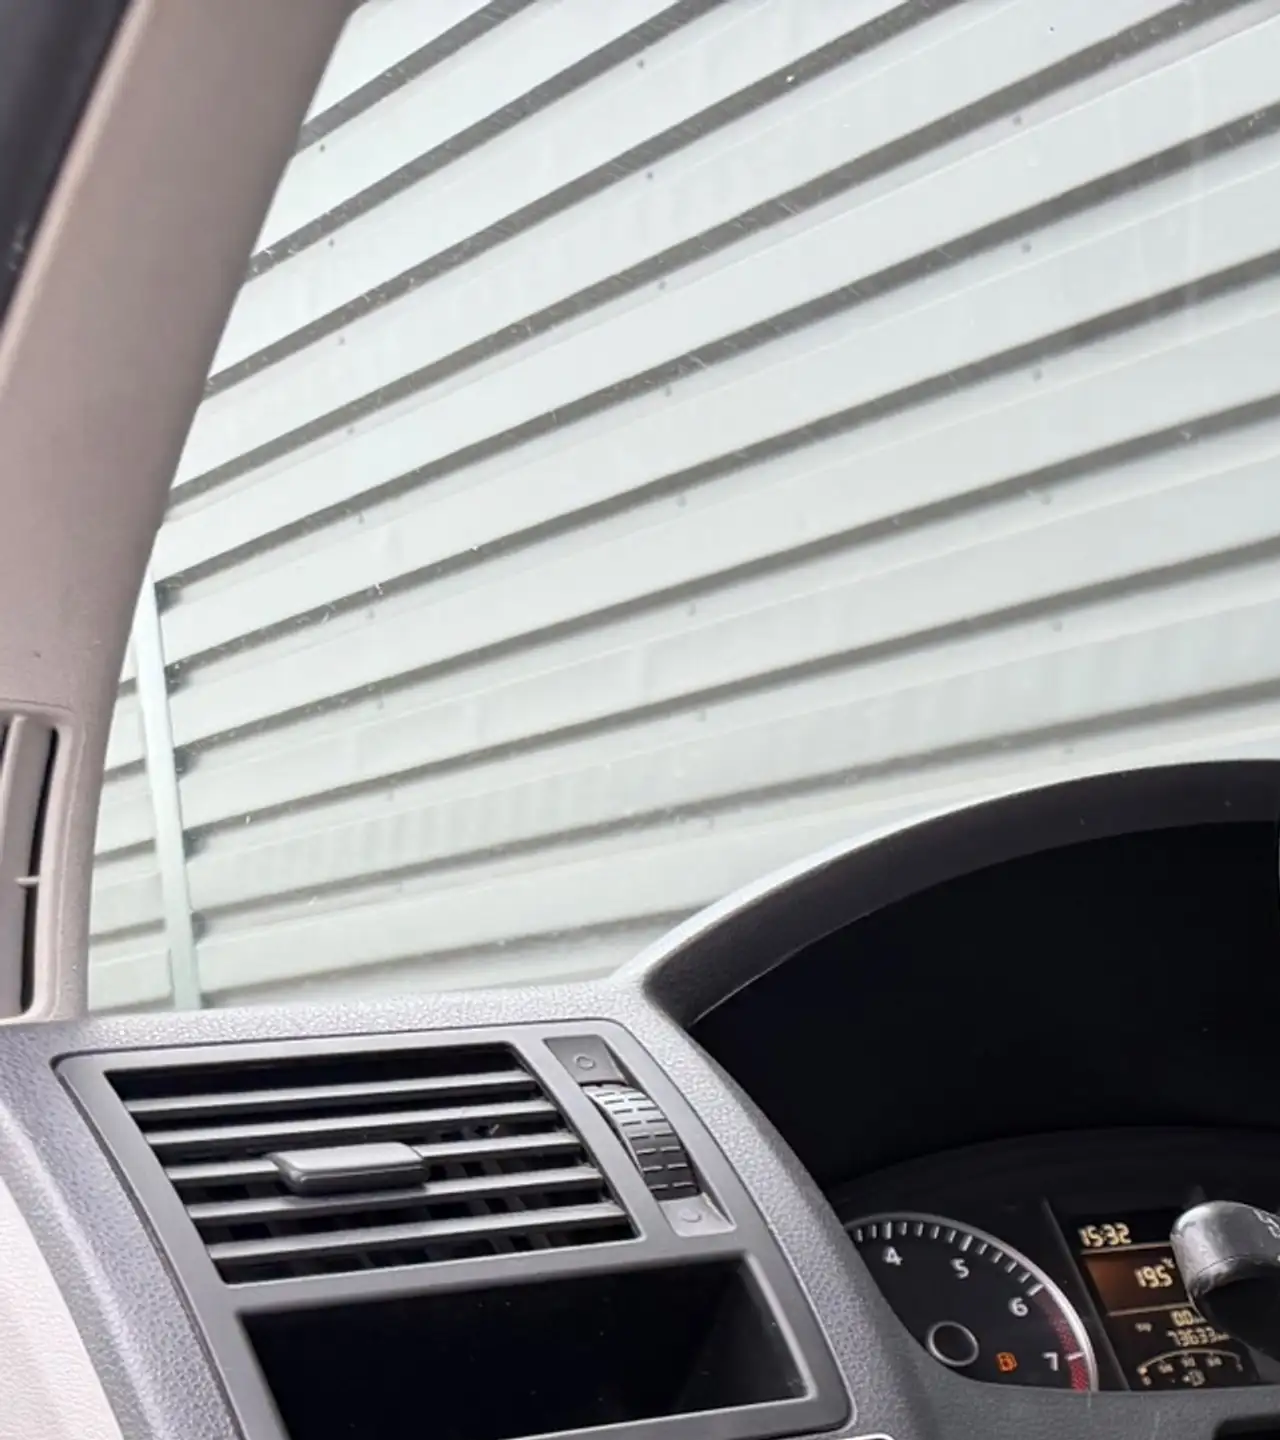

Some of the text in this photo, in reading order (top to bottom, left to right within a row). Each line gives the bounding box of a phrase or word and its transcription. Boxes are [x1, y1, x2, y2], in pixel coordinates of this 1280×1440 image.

[883, 1245, 903, 1266] 4
[951, 1257, 970, 1279] 5
[1008, 1296, 1029, 1317] 6
[1041, 1352, 1059, 1372] 7
